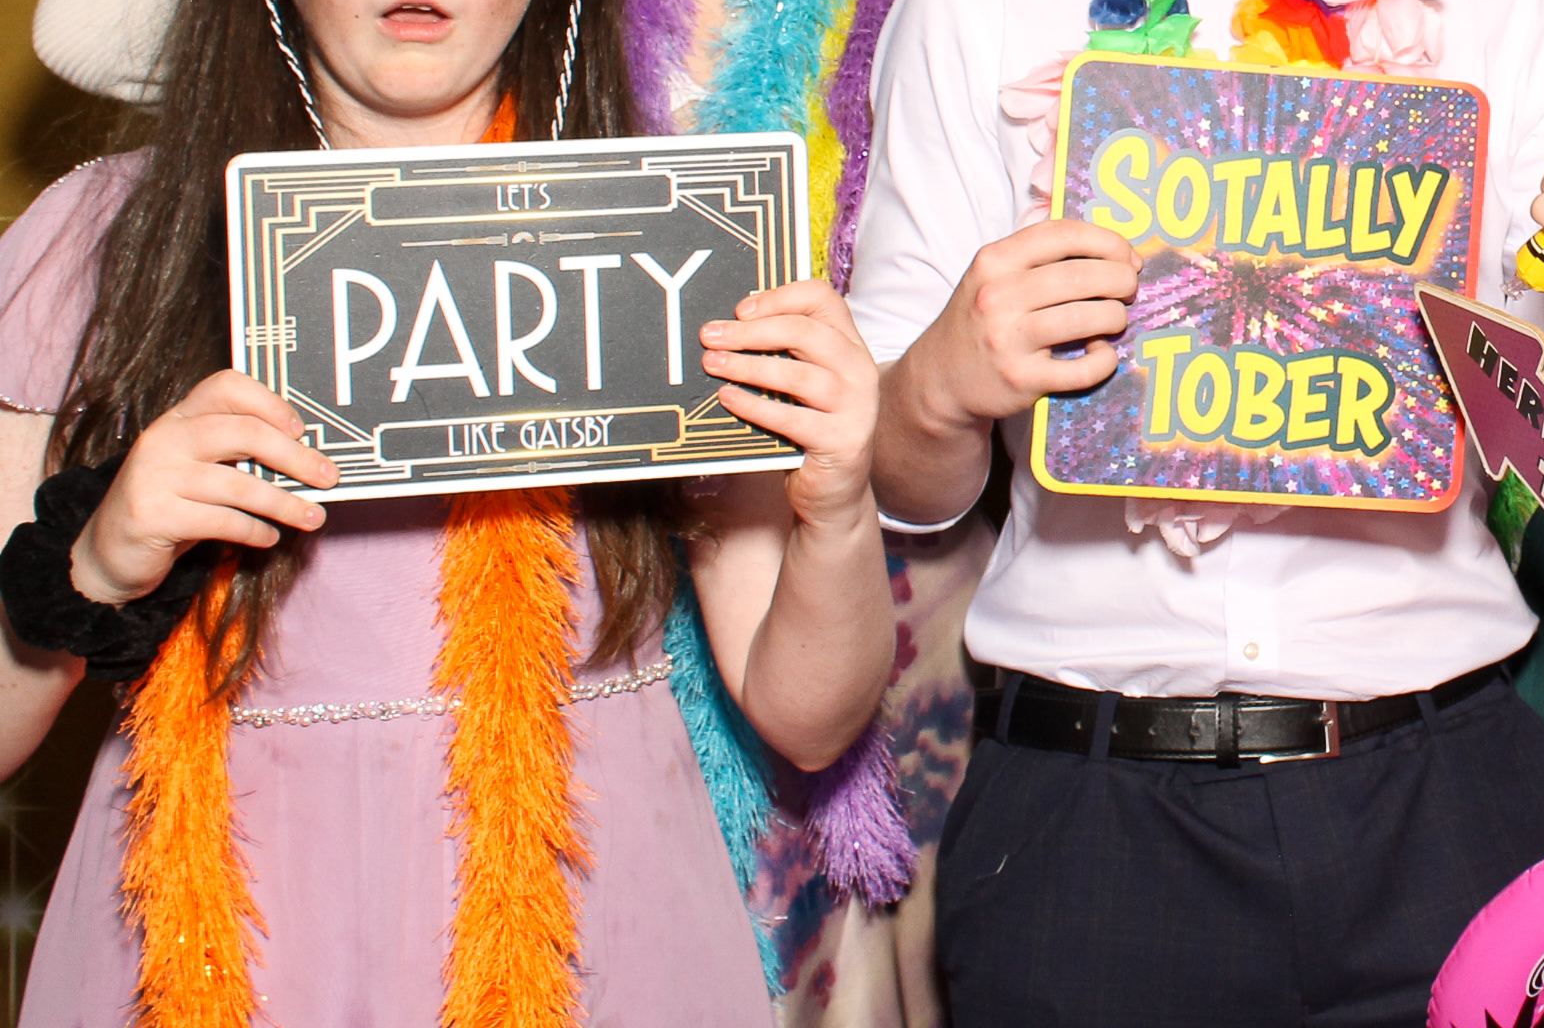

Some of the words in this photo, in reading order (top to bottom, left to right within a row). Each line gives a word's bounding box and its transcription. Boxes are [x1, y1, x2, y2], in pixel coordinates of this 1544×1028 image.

[495, 182, 553, 212] LET'S
[1088, 132, 1446, 262] SOTALLY
[331, 249, 714, 406] PARTY
[448, 422, 506, 457] LIKE
[519, 414, 616, 451] GATSBY
[1140, 332, 1393, 454] TOBER
